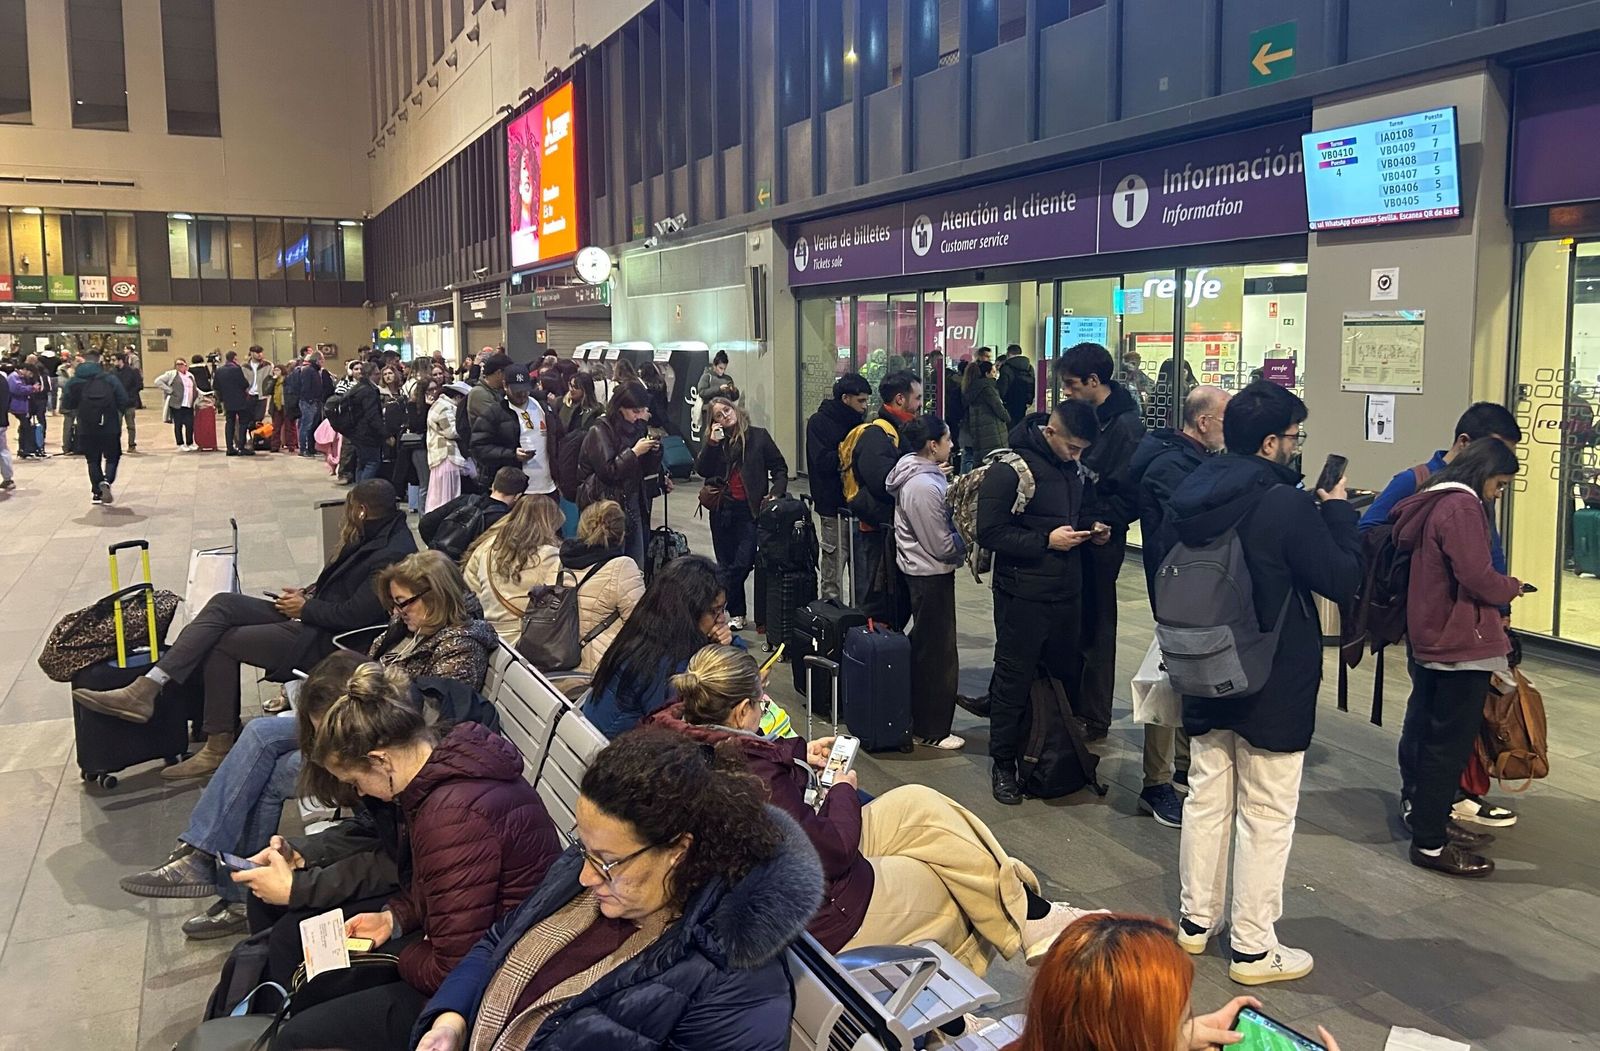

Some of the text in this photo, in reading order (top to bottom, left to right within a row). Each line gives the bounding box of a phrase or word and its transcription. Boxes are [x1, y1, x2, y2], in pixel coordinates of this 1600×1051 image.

[1424, 113, 1443, 121] Puesto
[1380, 124, 1437, 143] IA0108 7
[1321, 147, 1354, 161] VB0410
[1380, 138, 1438, 156] VB0409 7
[1381, 152, 1439, 169] VB0408 7
[1162, 147, 1304, 194] Información
[1336, 168, 1342, 177] 4
[1382, 166, 1440, 182] VB0407 5
[1382, 179, 1441, 195] VB0406 5
[1383, 193, 1442, 208] VB0405 5
[940, 191, 1077, 230] Atención al cliente
[1162, 195, 1243, 225] Information
[1324, 217, 1351, 228] WhatsApp
[1399, 211, 1423, 221] Escanea
[1424, 210, 1434, 220] QR
[1435, 208, 1443, 217] de
[1443, 207, 1454, 216] las
[813, 223, 890, 253] Venta de billetes
[940, 232, 1009, 253] Customer service
[813, 256, 843, 271] Tickets sale
